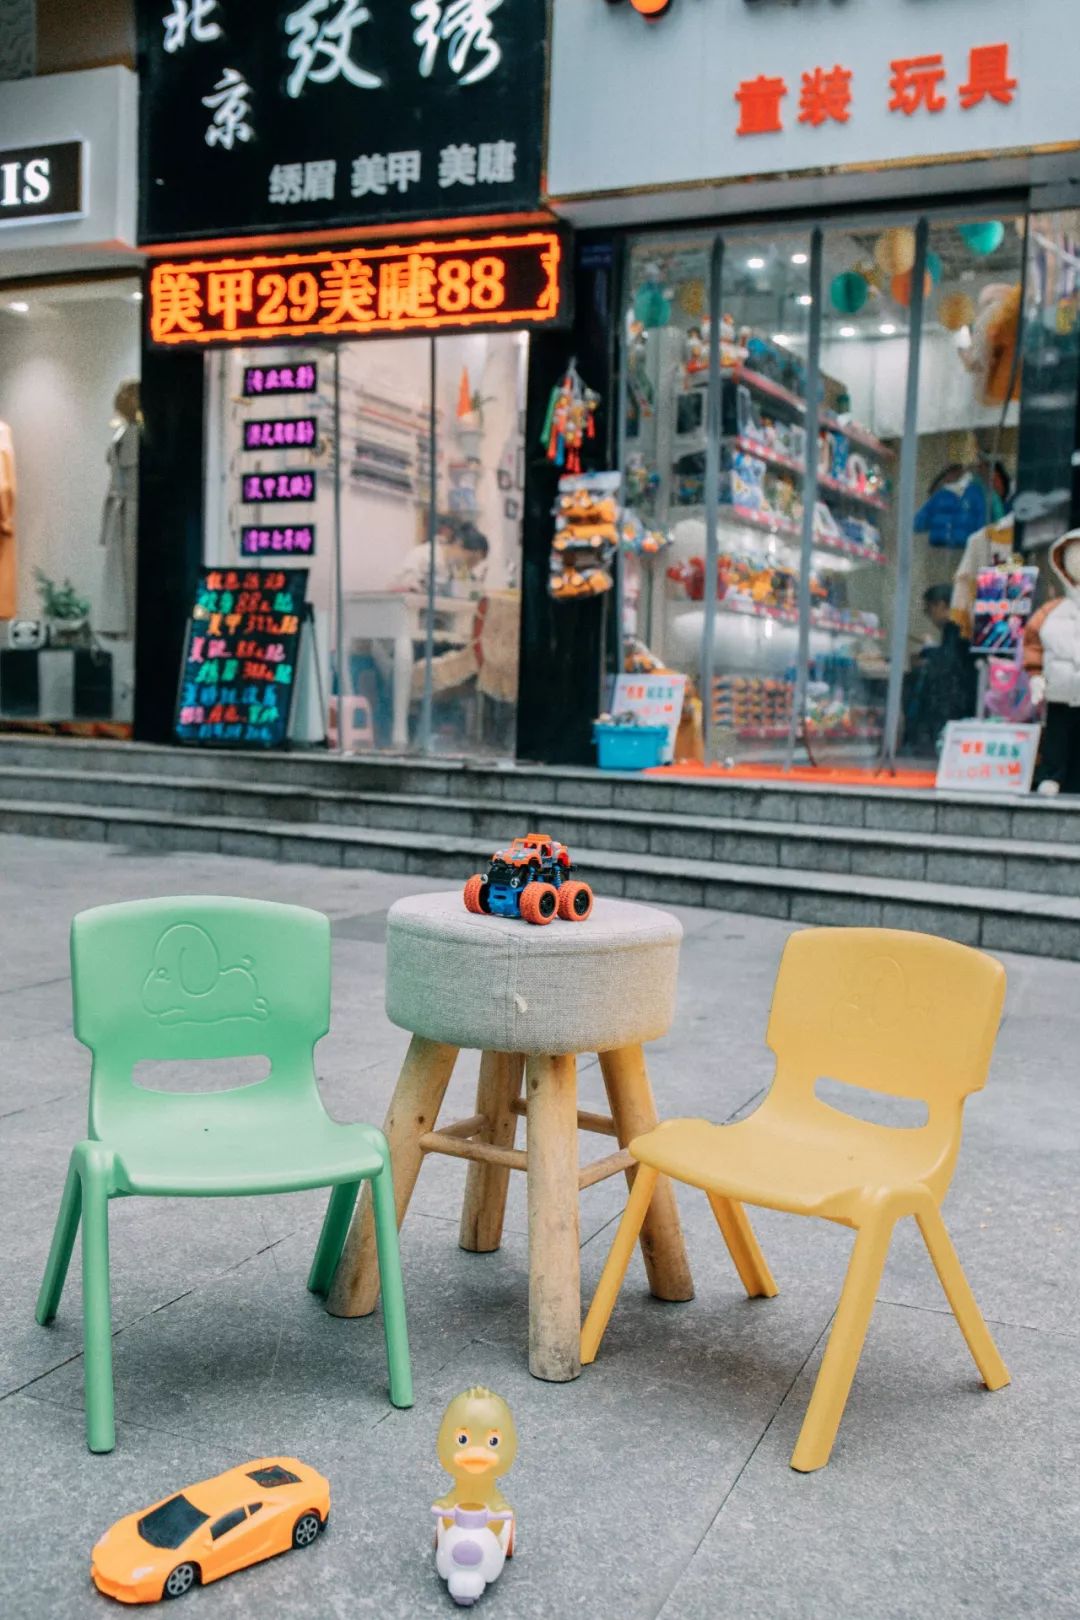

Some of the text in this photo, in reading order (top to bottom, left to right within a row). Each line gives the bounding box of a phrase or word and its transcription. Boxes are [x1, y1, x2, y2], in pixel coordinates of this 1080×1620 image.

[162, 0, 254, 150] 北京
[734, 43, 1017, 136] 童装 玩具
[0, 157, 50, 206] IS
[268, 139, 516, 204] 绣眉 美甲 美睫
